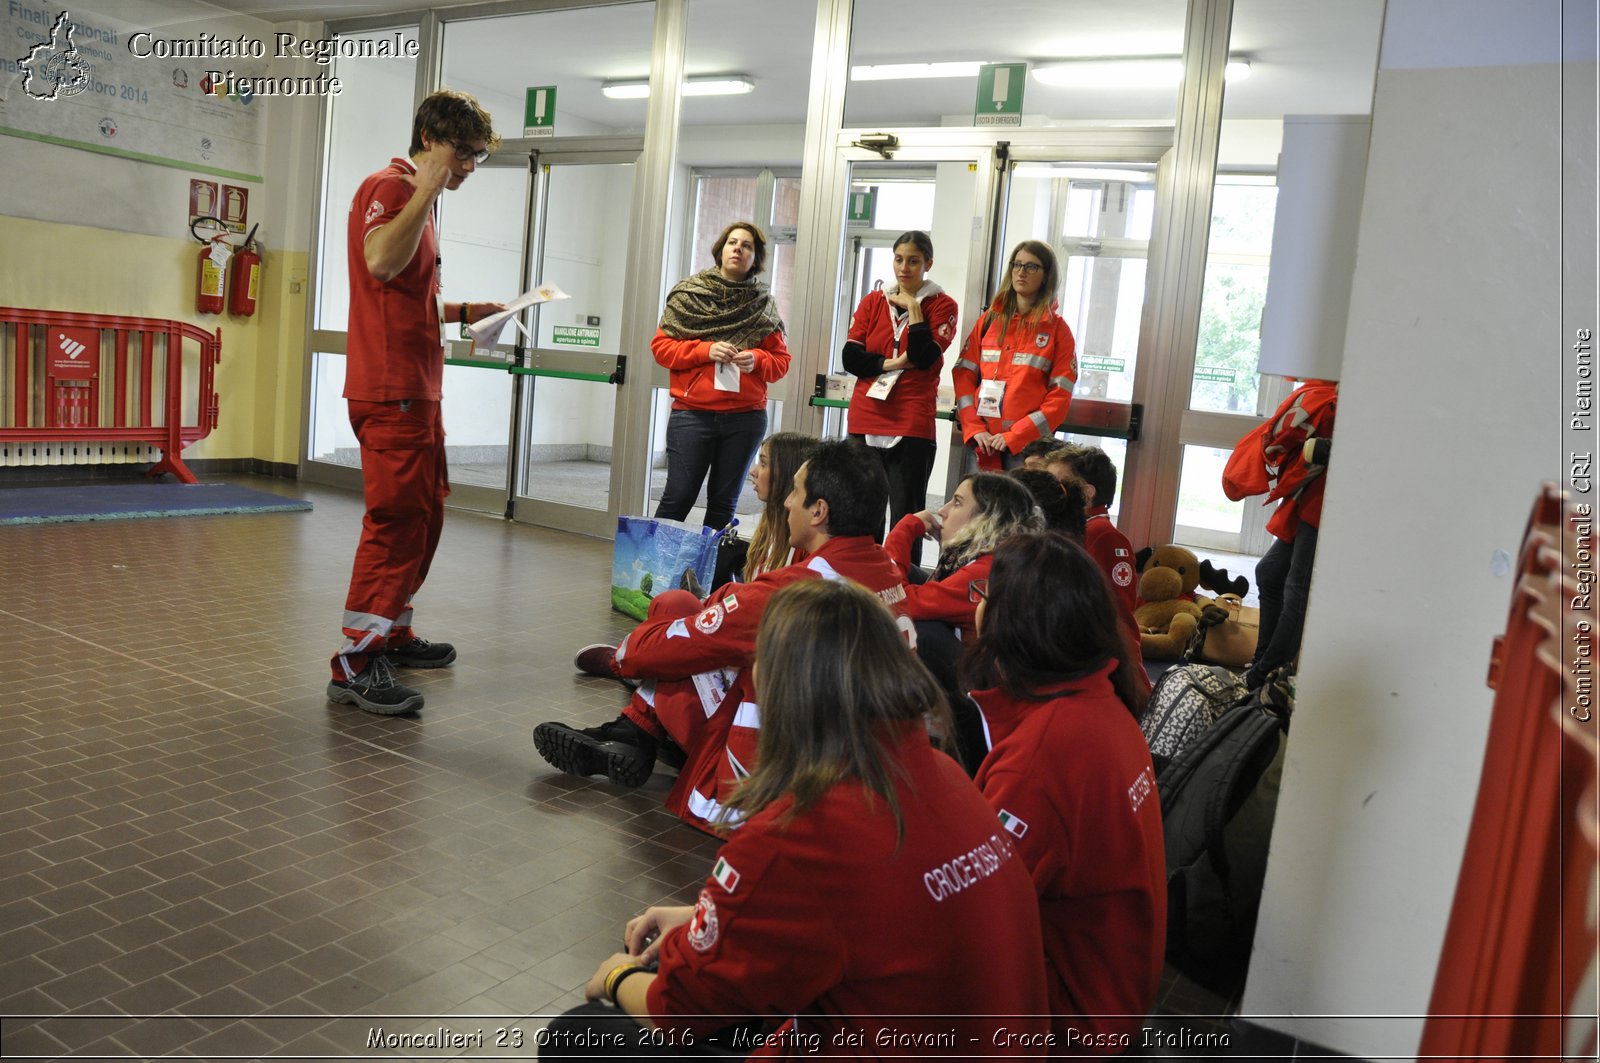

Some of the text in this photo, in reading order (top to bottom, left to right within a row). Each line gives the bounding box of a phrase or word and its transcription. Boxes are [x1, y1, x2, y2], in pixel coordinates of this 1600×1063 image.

[9, 1, 50, 26] Finali
[120, 84, 149, 104] 2014
[923, 855, 977, 901] CROCE
